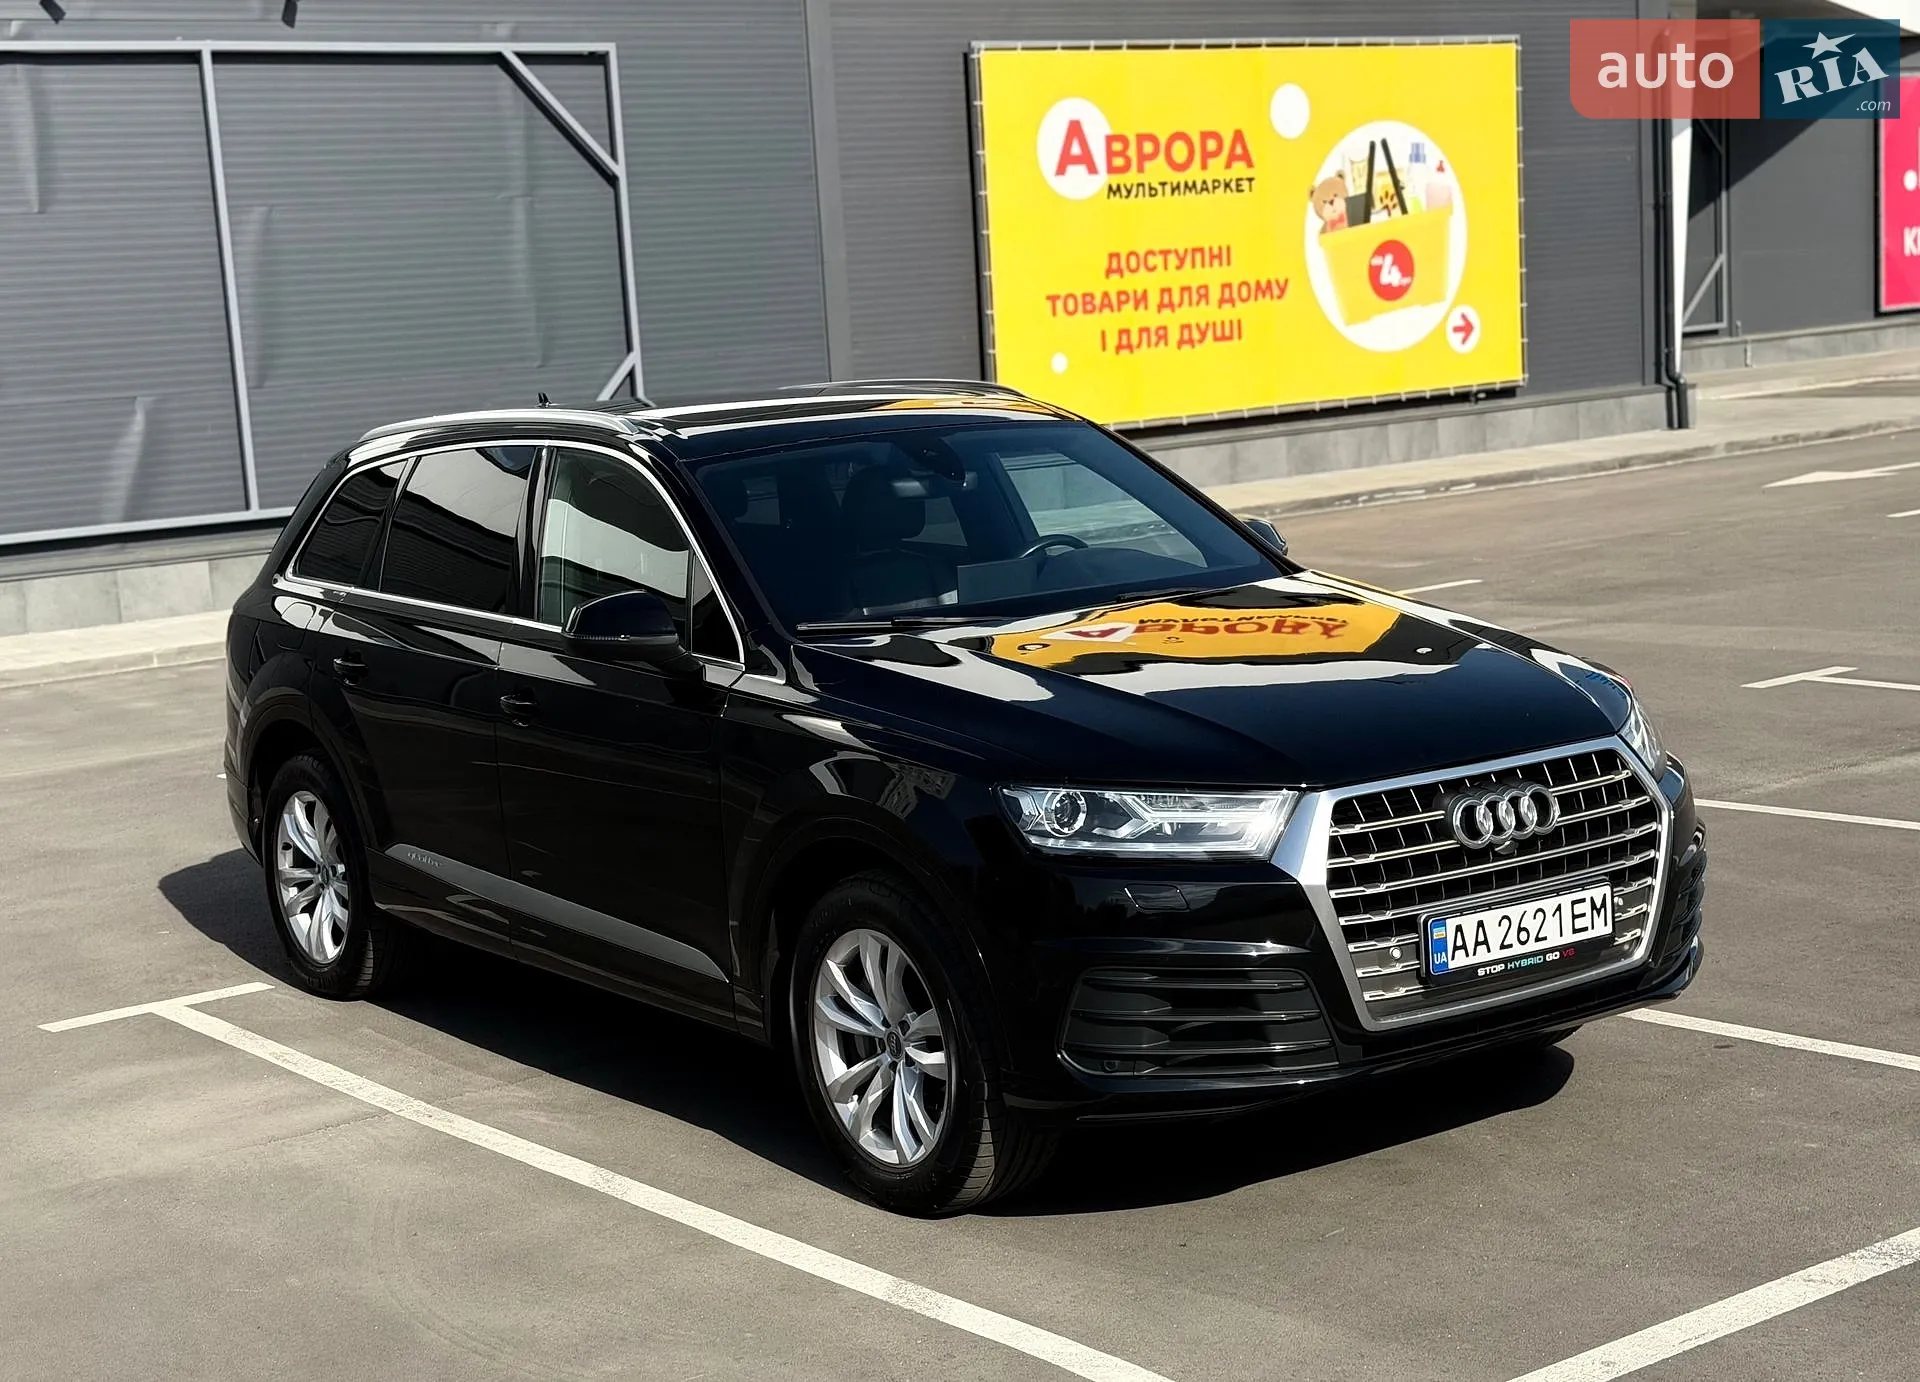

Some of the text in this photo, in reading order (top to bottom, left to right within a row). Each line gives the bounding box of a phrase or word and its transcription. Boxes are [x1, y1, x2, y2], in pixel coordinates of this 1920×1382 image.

[1055, 120, 1255, 176] АВРОРА
[1106, 178, 1256, 199] МУЛЬТИМАРКЕТ
[1105, 245, 1232, 279] ДОСТУПНІ
[1046, 278, 1289, 317] ТОВАРИ ДЛЯ ДОМУ
[1100, 319, 1243, 354] І ДЛЯ ДУШІ
[1451, 892, 1608, 961] AA 2621 EM
[1433, 952, 1447, 965] UA
[1477, 963, 1505, 976] STOP
[1507, 955, 1544, 970] HYBRID
[1545, 951, 1560, 962] GO
